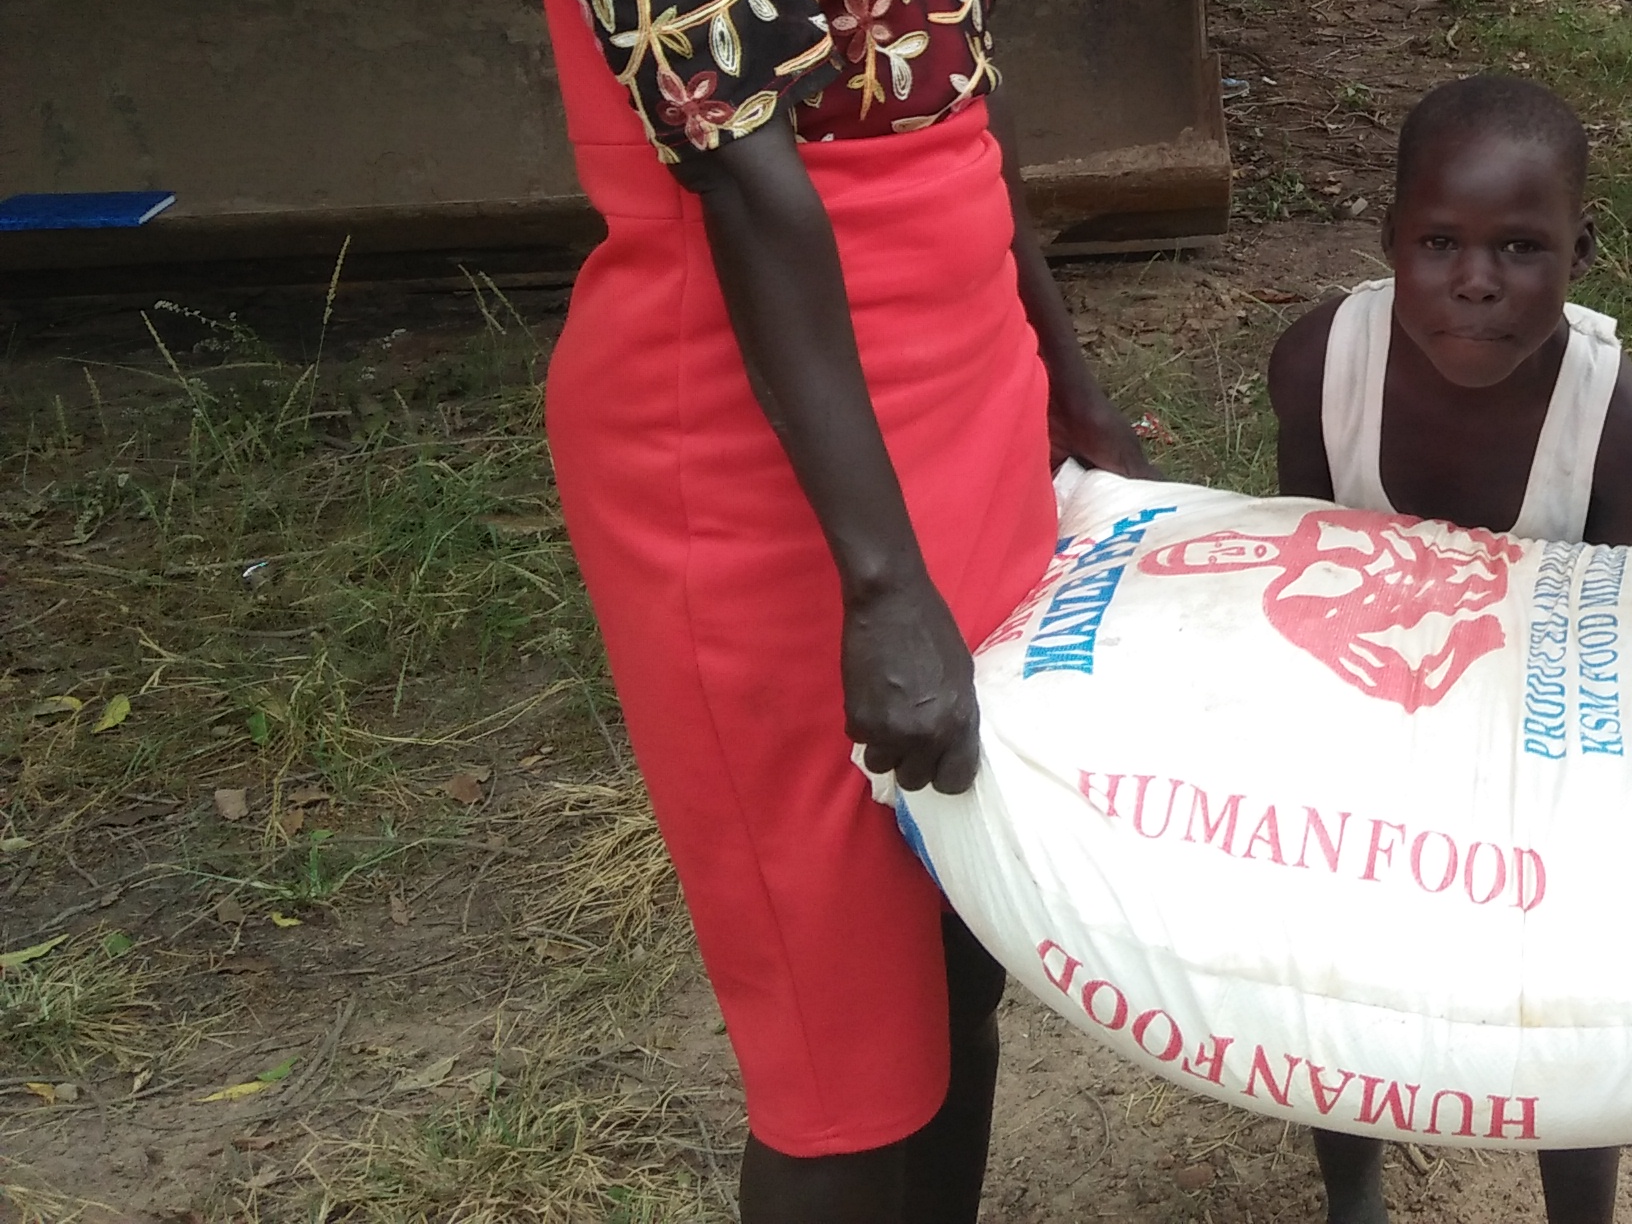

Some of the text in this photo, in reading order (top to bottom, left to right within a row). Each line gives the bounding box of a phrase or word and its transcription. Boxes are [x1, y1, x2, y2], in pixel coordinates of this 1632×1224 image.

[1577, 612, 1620, 684] FOOD
[1578, 684, 1624, 757] KSM
[1077, 768, 1547, 913] HUMAN FOOD
[1036, 938, 1541, 1140] HUMAN FOOD
